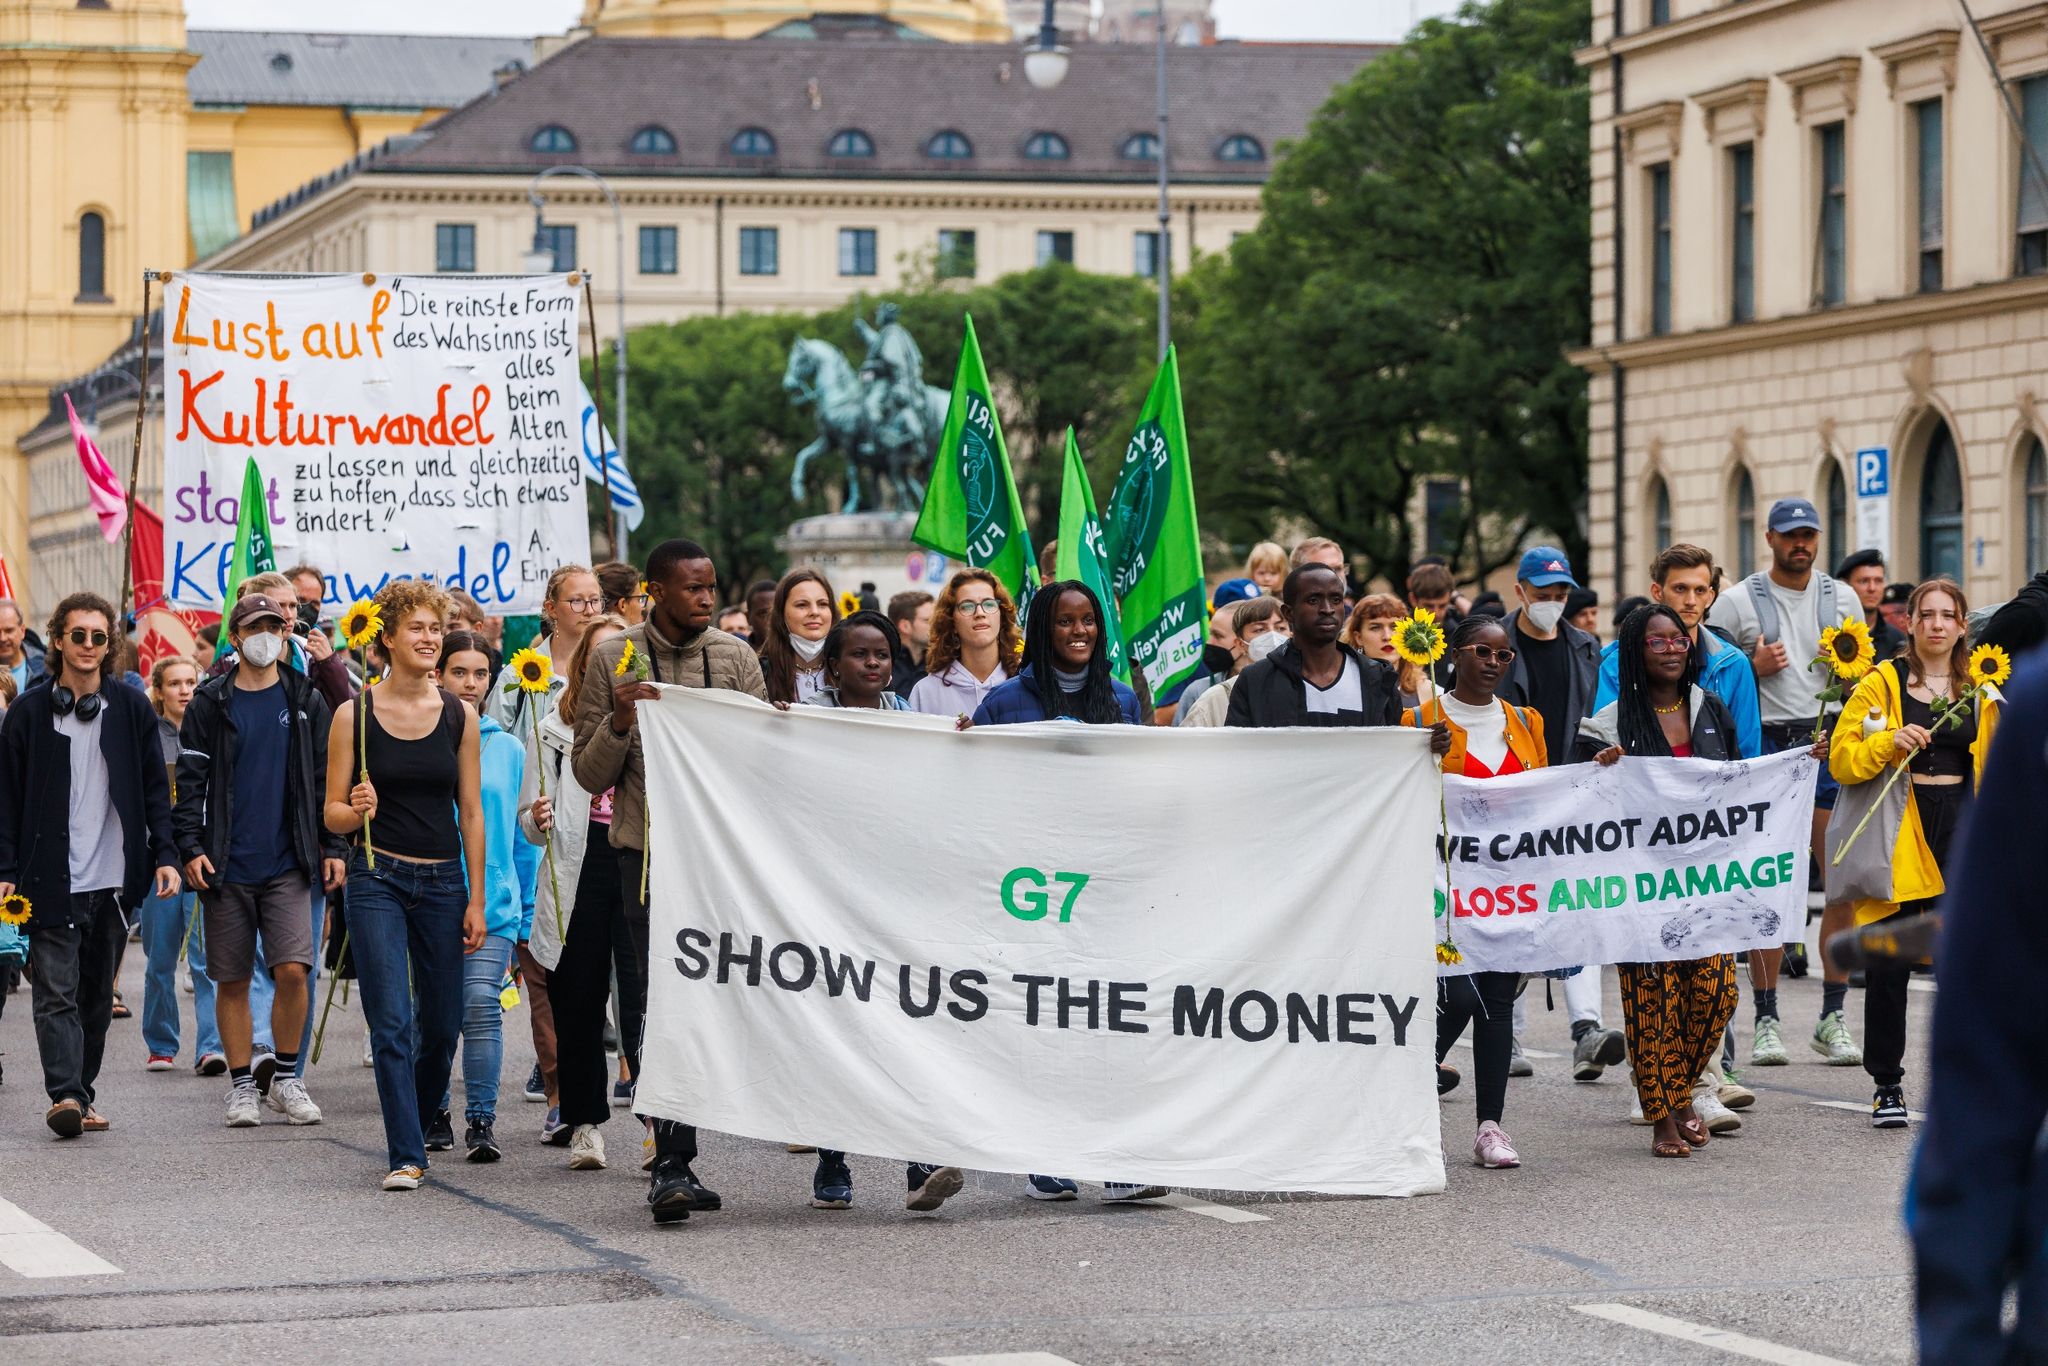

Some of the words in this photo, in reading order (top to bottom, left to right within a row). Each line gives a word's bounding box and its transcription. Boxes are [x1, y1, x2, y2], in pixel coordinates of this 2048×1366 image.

[447, 291, 520, 317] reinste
[526, 289, 574, 313] Form
[173, 286, 290, 361] Lust
[303, 290, 391, 359] auf
[393, 322, 429, 349] des
[431, 322, 537, 352] Wahsinns
[505, 353, 555, 380] alles
[176, 369, 495, 446] Kulturwandel
[507, 383, 560, 411] beim
[509, 415, 568, 440] Alten
[415, 449, 457, 477] und
[470, 447, 580, 486] gleichzeitig
[1860, 453, 1881, 494] P
[293, 487, 323, 502] zu
[408, 480, 456, 507] dass
[464, 481, 509, 507] sich
[517, 484, 570, 504] etwas
[528, 528, 550, 553] A.
[1490, 818, 1642, 863] CANNOT
[1648, 802, 1771, 847] ADAPT
[1000, 866, 1090, 923] G7
[1452, 883, 1538, 918] LOSS
[1547, 875, 1628, 912] AND
[1635, 851, 1795, 903] DAMAGE
[674, 928, 876, 1002] SHOW
[898, 965, 989, 1021] US
[1012, 974, 1149, 1034] THE
[1173, 985, 1419, 1046] MONEY
